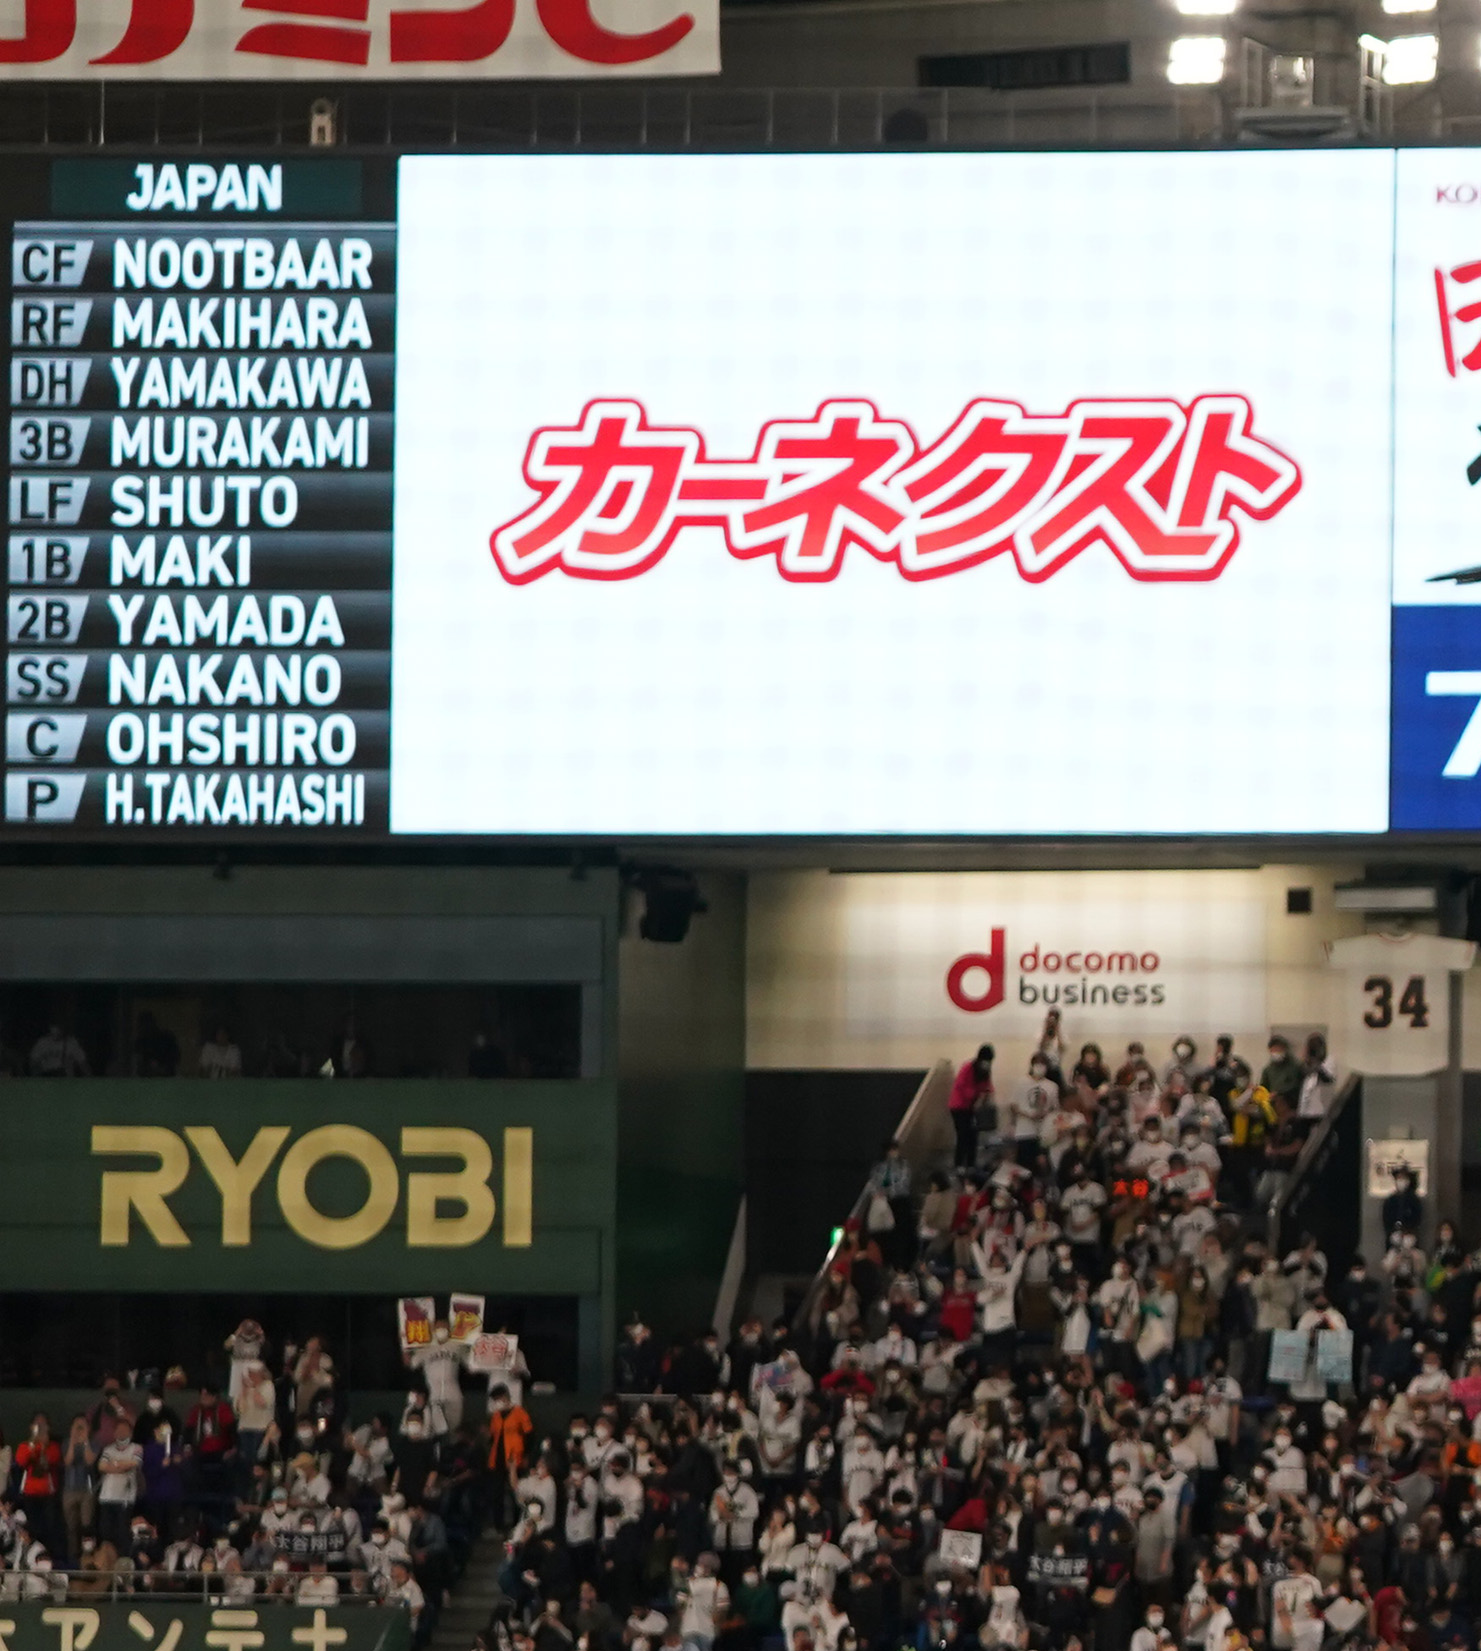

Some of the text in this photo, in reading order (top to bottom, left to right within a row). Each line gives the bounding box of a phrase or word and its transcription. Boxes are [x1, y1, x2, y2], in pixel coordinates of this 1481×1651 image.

[126, 164, 283, 212] JAPAN
[21, 239, 372, 289] CF NOOTBAAR
[21, 298, 372, 349] RF MAKIHARA
[20, 358, 371, 408] DH YAMAKAWA
[19, 417, 369, 467] 3B MURAKAMI
[18, 477, 298, 528] LF SHUTO
[490, 394, 1302, 585] カーネクスト
[21, 536, 251, 587] 1B MAKI
[17, 594, 345, 647] 2B YAMADA
[16, 654, 342, 706] SS NAKANO
[26, 713, 357, 765] C OHSHIRO
[25, 774, 366, 825] P H.TAKAHASHI
[1019, 942, 1160, 973] docomo
[1019, 975, 1166, 1006] business
[1363, 975, 1429, 1029] 34
[90, 1123, 534, 1250] RYOBI
